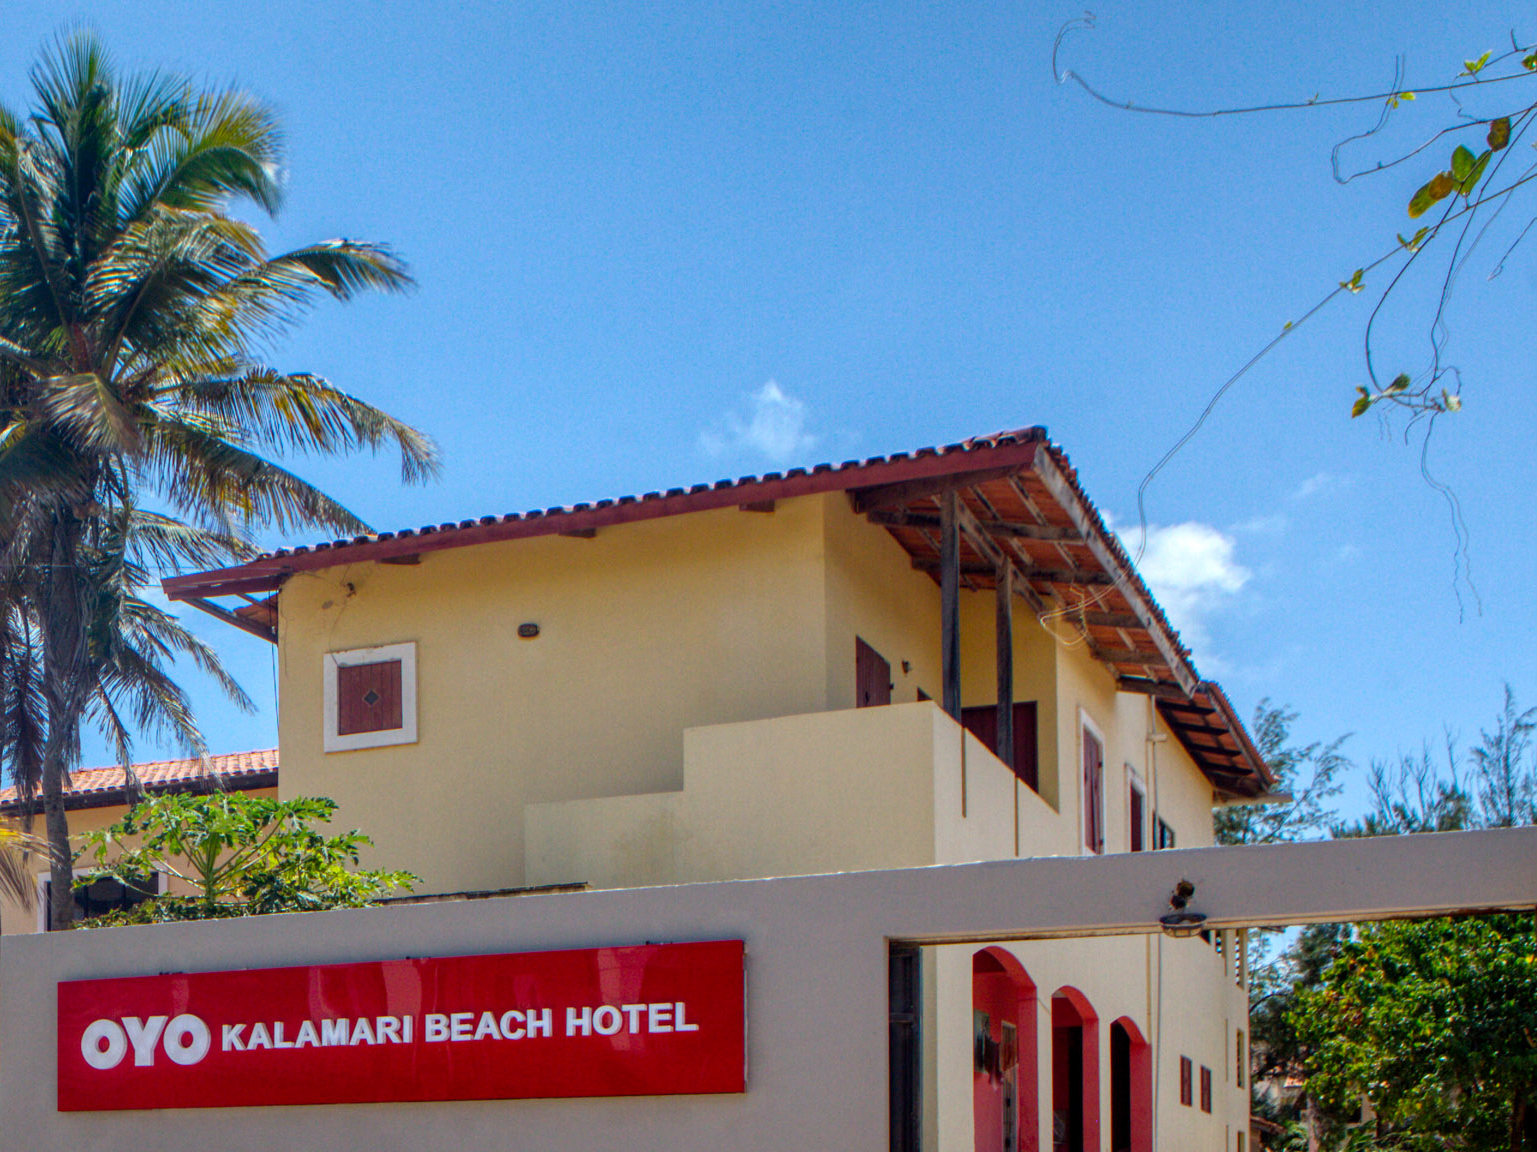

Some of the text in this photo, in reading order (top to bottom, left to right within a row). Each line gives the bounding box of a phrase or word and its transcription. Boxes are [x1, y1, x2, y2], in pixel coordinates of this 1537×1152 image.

[81, 1002, 700, 1069] OYO KALAMARI BEACH HOTEL
